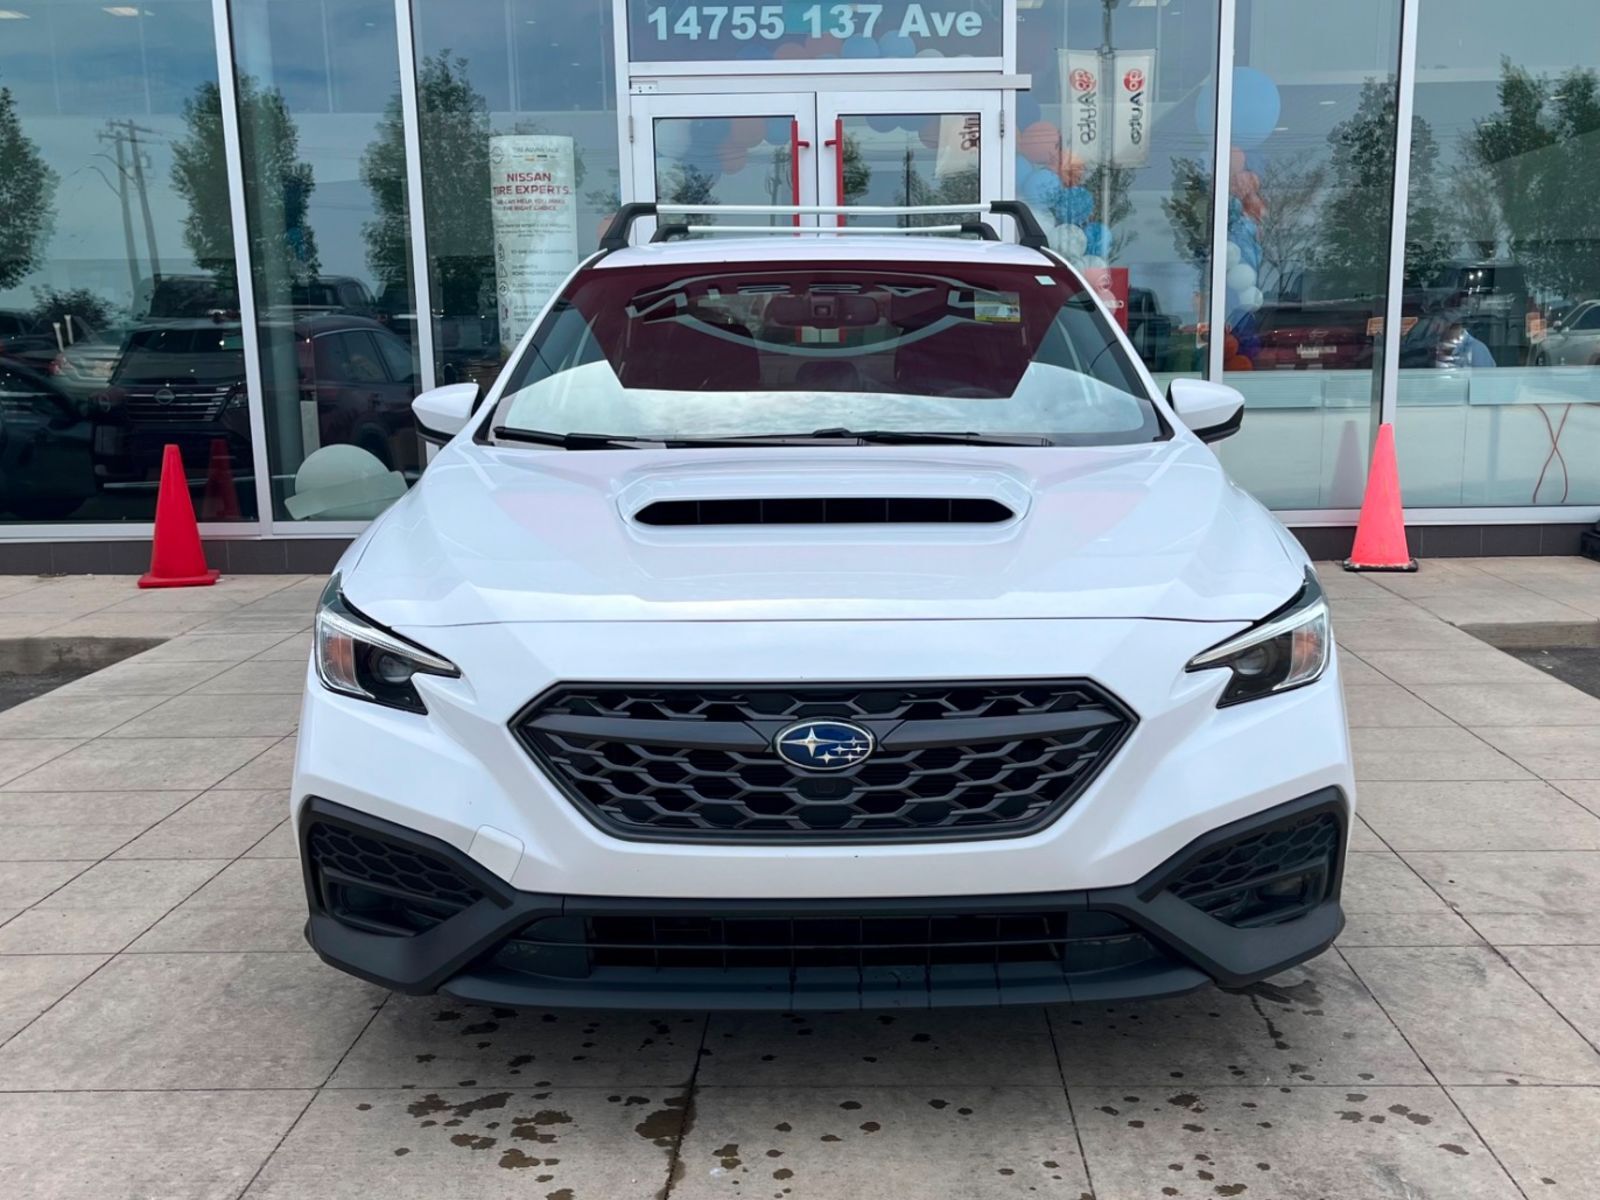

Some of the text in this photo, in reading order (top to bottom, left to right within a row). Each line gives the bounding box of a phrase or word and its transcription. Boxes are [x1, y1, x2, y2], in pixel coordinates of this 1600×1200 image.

[648, 3, 982, 41] 14755 137 Ave
[507, 172, 552, 182] NISSAN
[493, 185, 512, 195] TIRE
